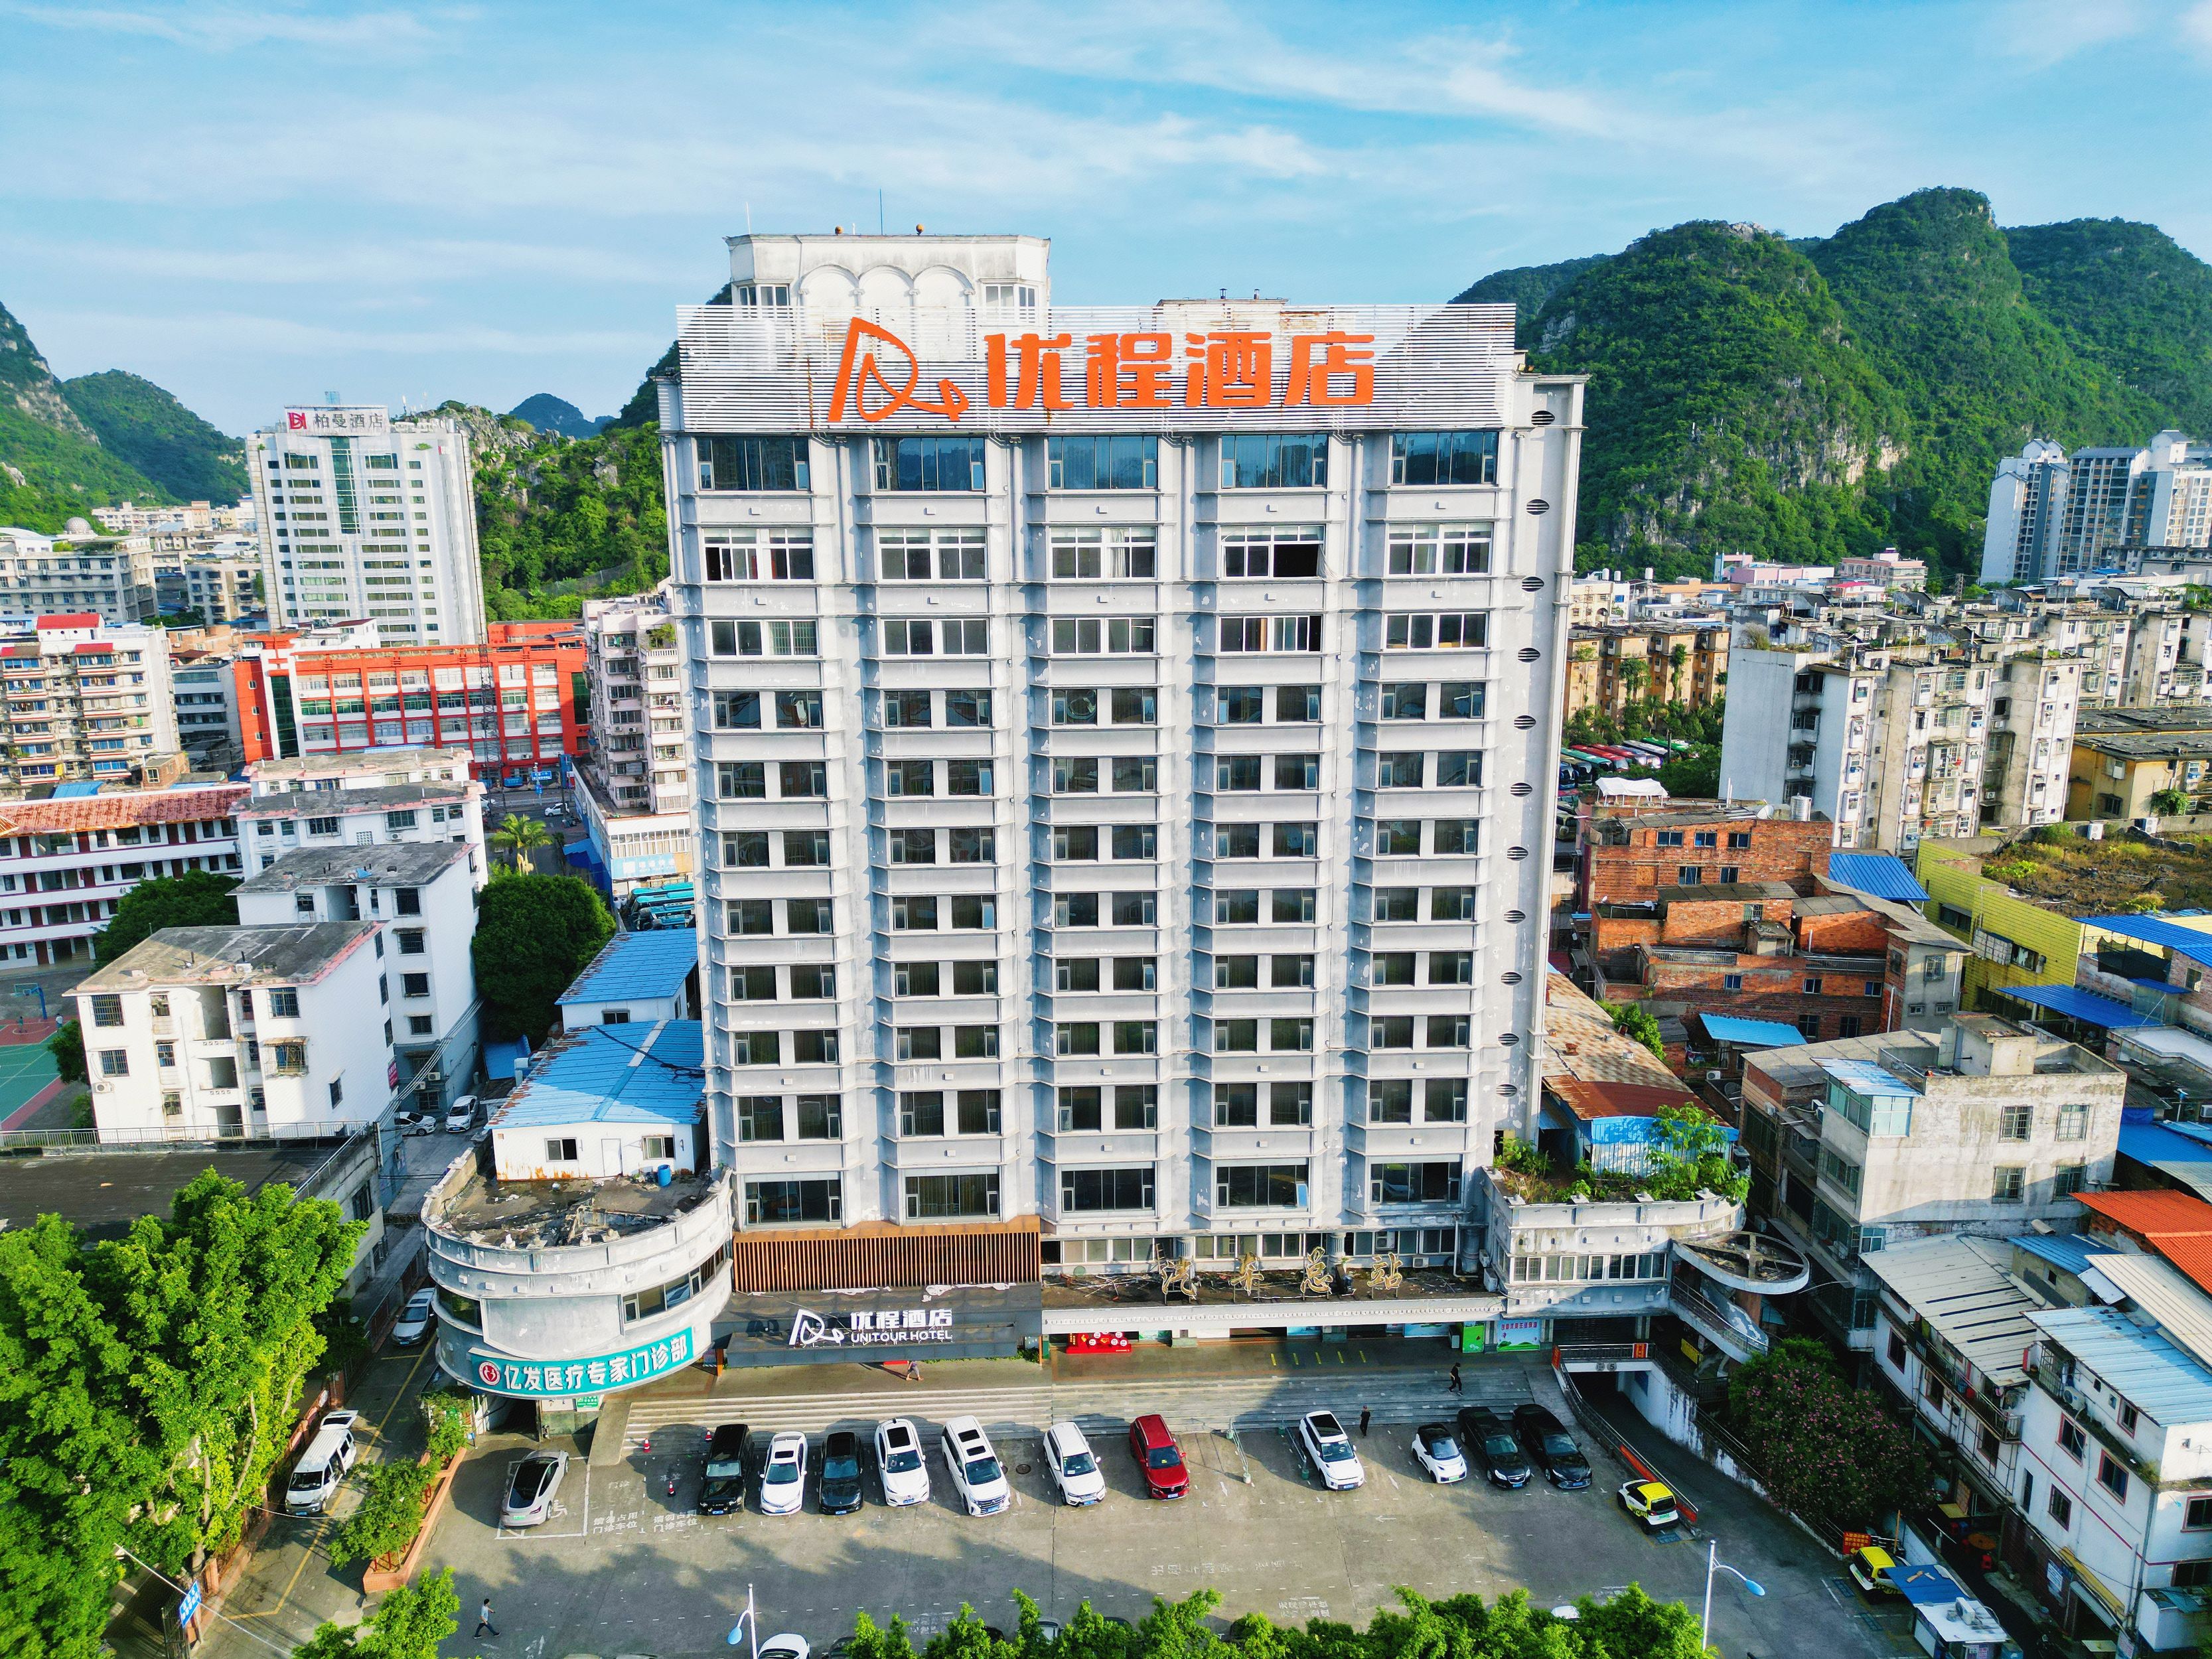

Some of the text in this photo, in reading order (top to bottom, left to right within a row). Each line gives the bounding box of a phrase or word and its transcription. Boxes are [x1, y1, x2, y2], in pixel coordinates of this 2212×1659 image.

[984, 330, 1375, 409] 优程酒店
[314, 413, 383, 429] 柏曼酒店
[1160, 1246, 1403, 1299] 汽车总站
[850, 1309, 952, 1330] 优程酒店
[851, 1330, 953, 1343] UNITOUR HOTEL
[504, 1334, 688, 1391] 亿发医疗专家门诊部
[593, 1520, 638, 1534] 门诊车位
[654, 1518, 698, 1533] 门诊车位
